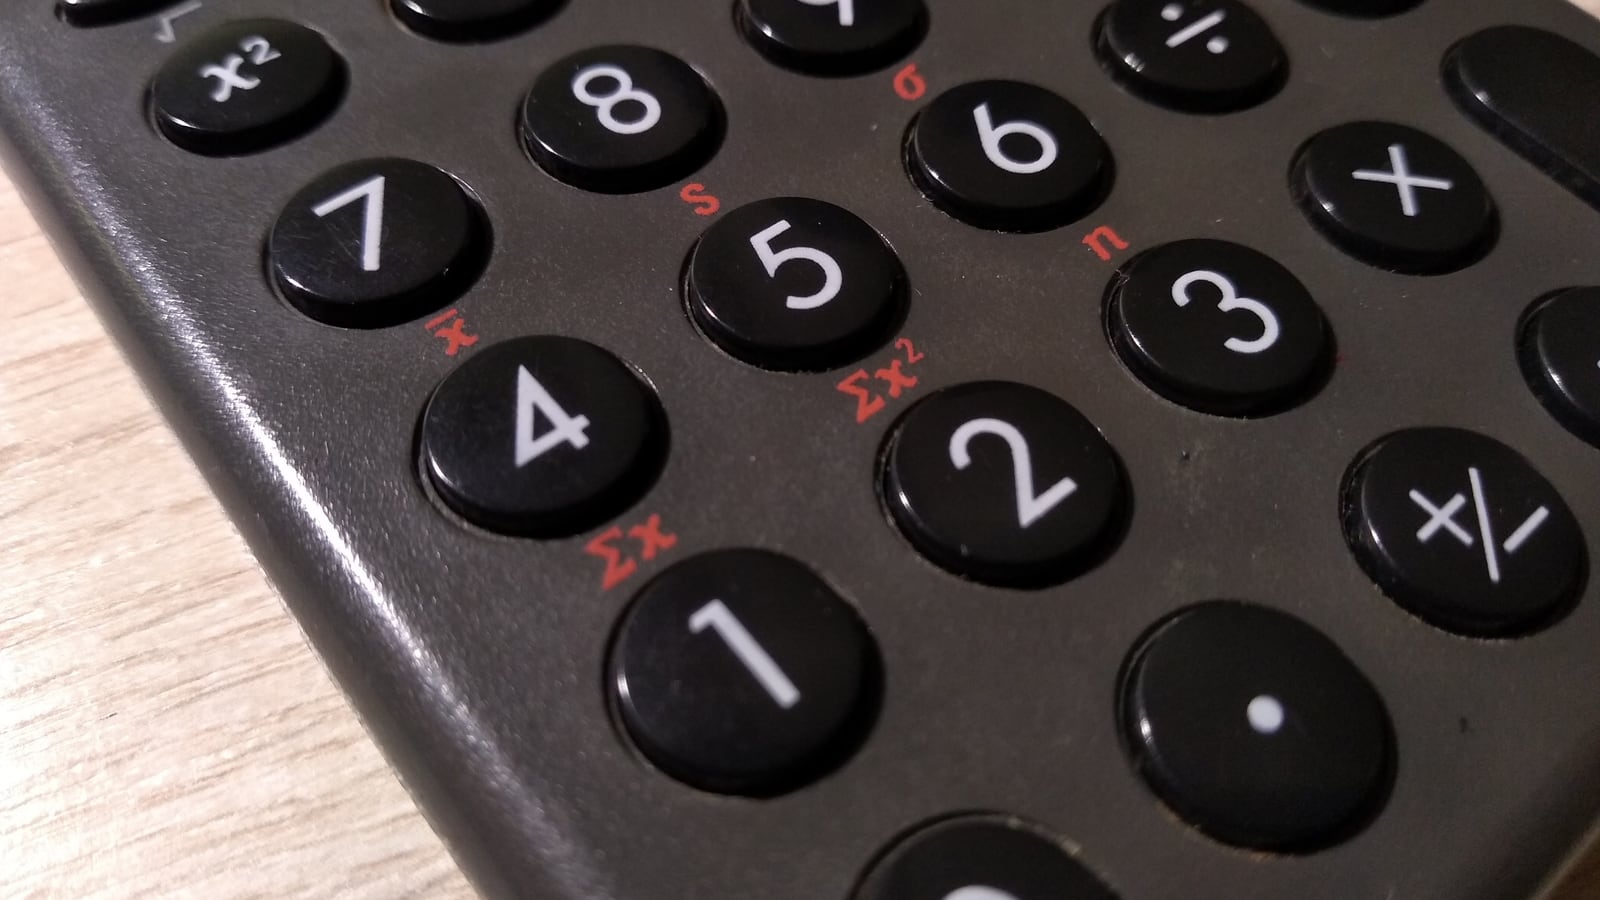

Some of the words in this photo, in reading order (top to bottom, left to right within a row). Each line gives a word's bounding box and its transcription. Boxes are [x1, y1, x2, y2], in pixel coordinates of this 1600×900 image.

[571, 64, 663, 135] 8
[972, 102, 1058, 175] 6
[311, 174, 387, 273] 7
[749, 218, 843, 311] 5
[1081, 224, 1131, 262] n
[1170, 269, 1280, 355] 3
[514, 363, 591, 468] 4
[948, 417, 1078, 528] 2
[688, 599, 800, 707] 1
